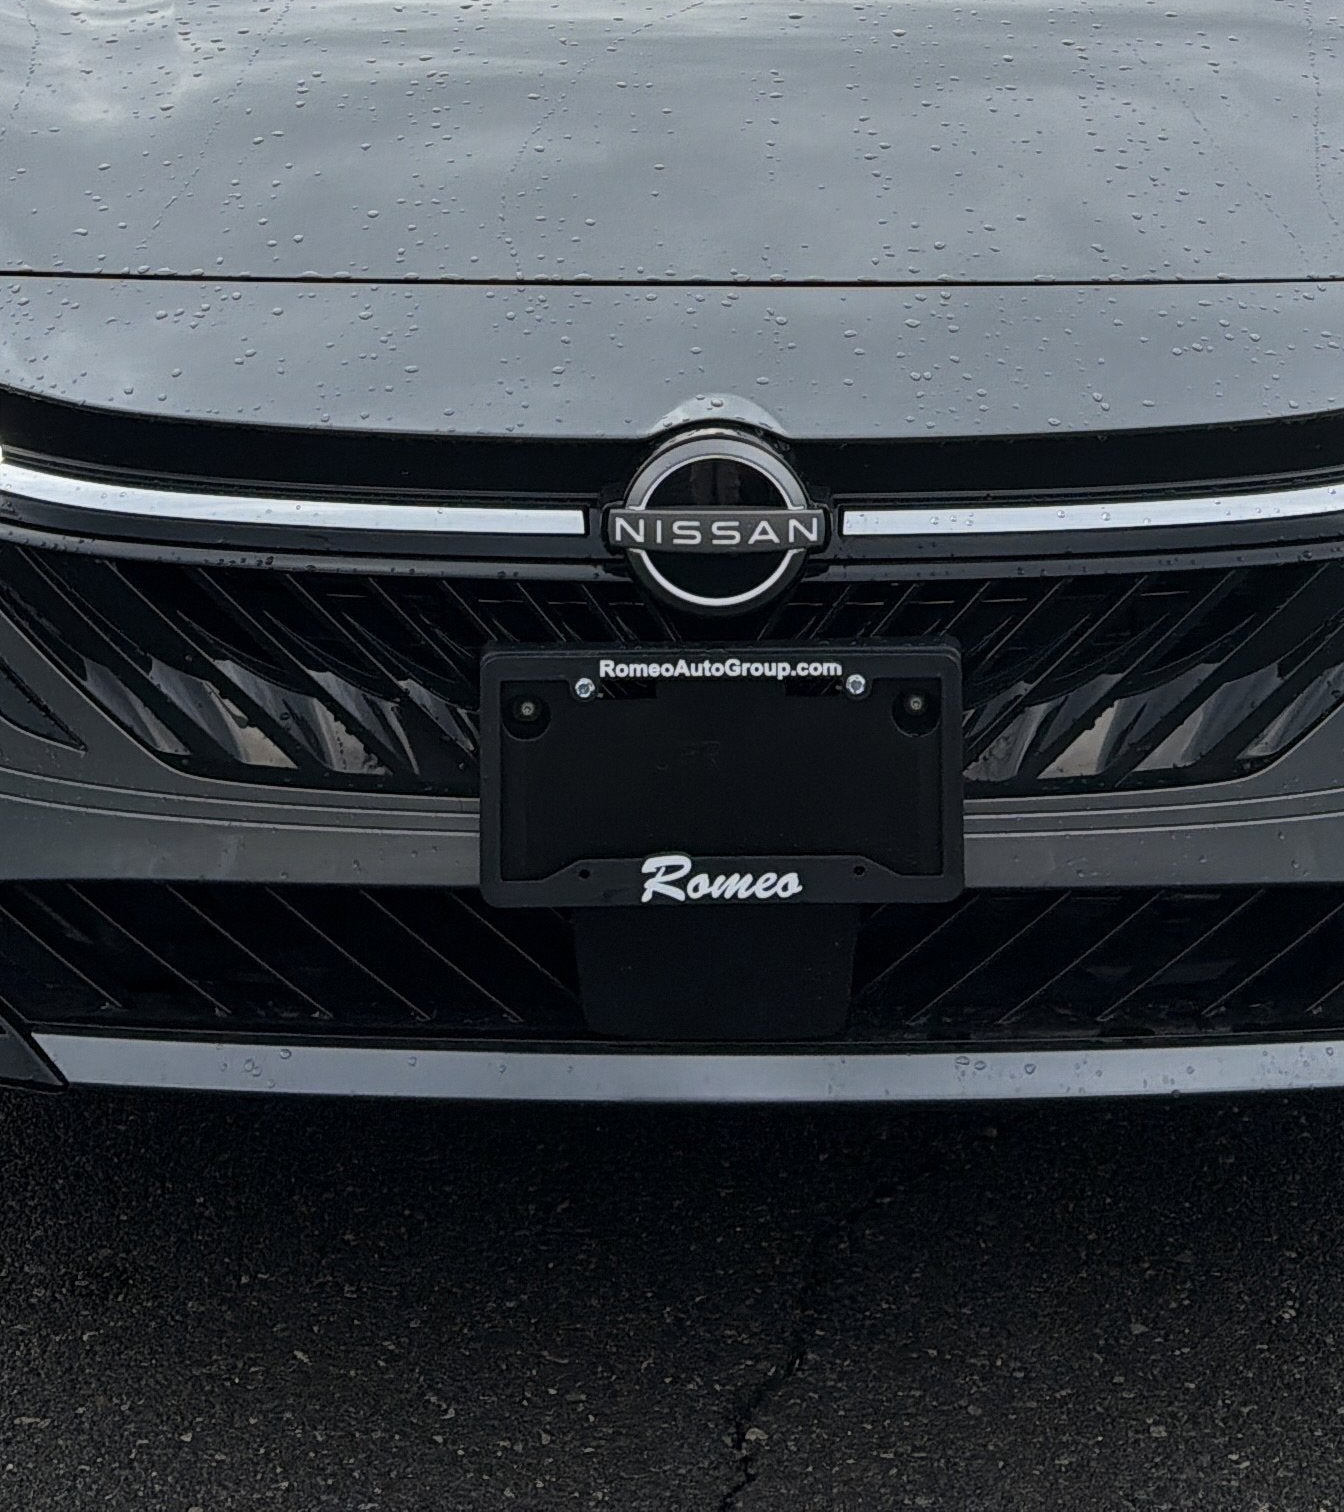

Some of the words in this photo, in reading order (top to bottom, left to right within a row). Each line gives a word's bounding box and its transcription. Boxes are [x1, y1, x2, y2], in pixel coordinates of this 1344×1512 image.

[615, 517, 818, 545] NISSAN
[599, 659, 843, 680] RomeoAutoGroup.com
[641, 855, 803, 903] Romeo
